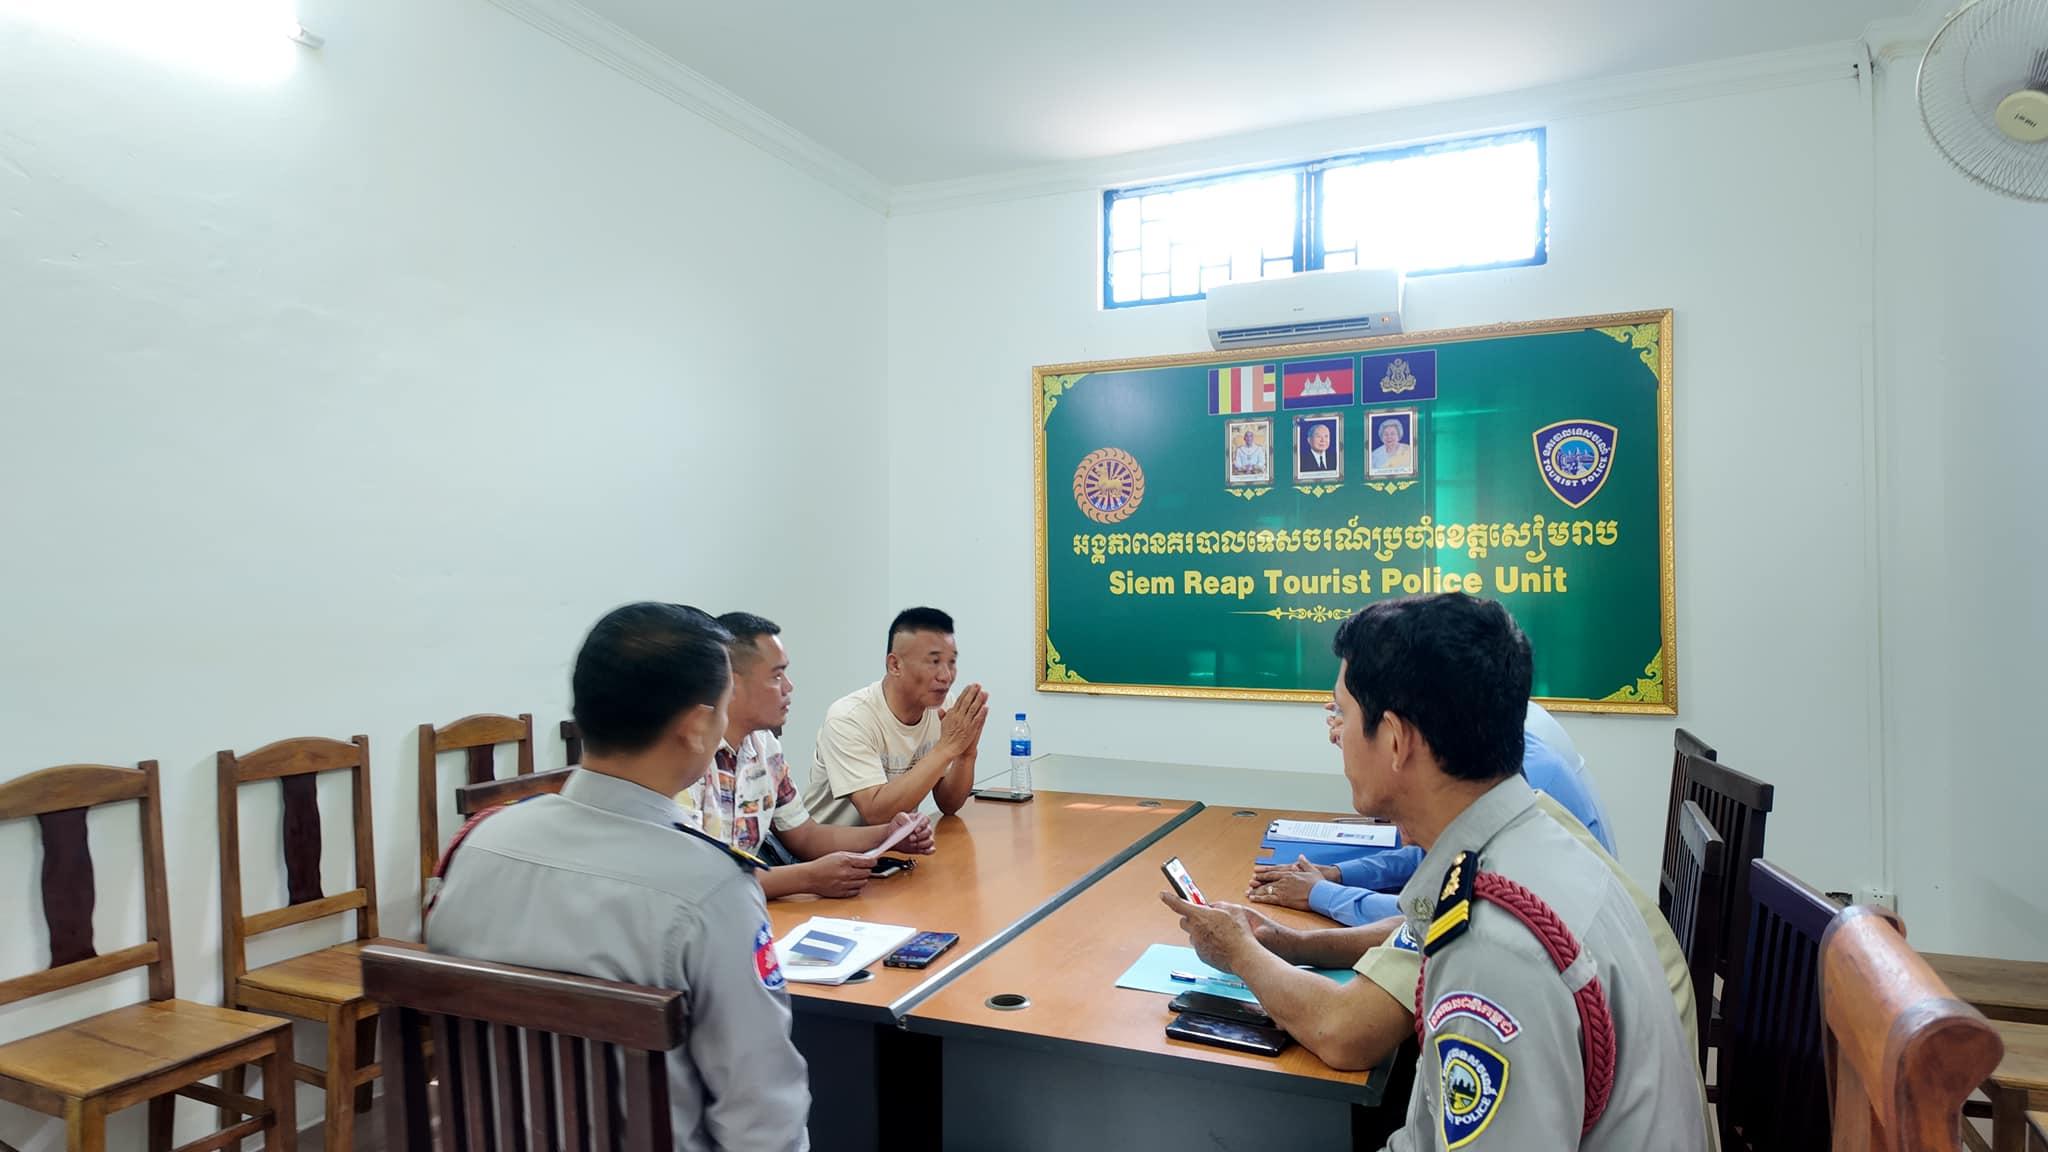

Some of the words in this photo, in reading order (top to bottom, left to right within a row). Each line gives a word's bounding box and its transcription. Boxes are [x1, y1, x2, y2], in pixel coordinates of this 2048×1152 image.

[1543, 458, 1579, 487] TOURIST
[1580, 456, 1608, 486] POLICE
[1109, 570, 1175, 595] Siem
[1184, 570, 1255, 599] Reap
[1263, 568, 1371, 595] Tourist
[1381, 566, 1483, 594] Police
[1495, 565, 1567, 594] Unit
[1454, 1096, 1492, 1126] POLICE
